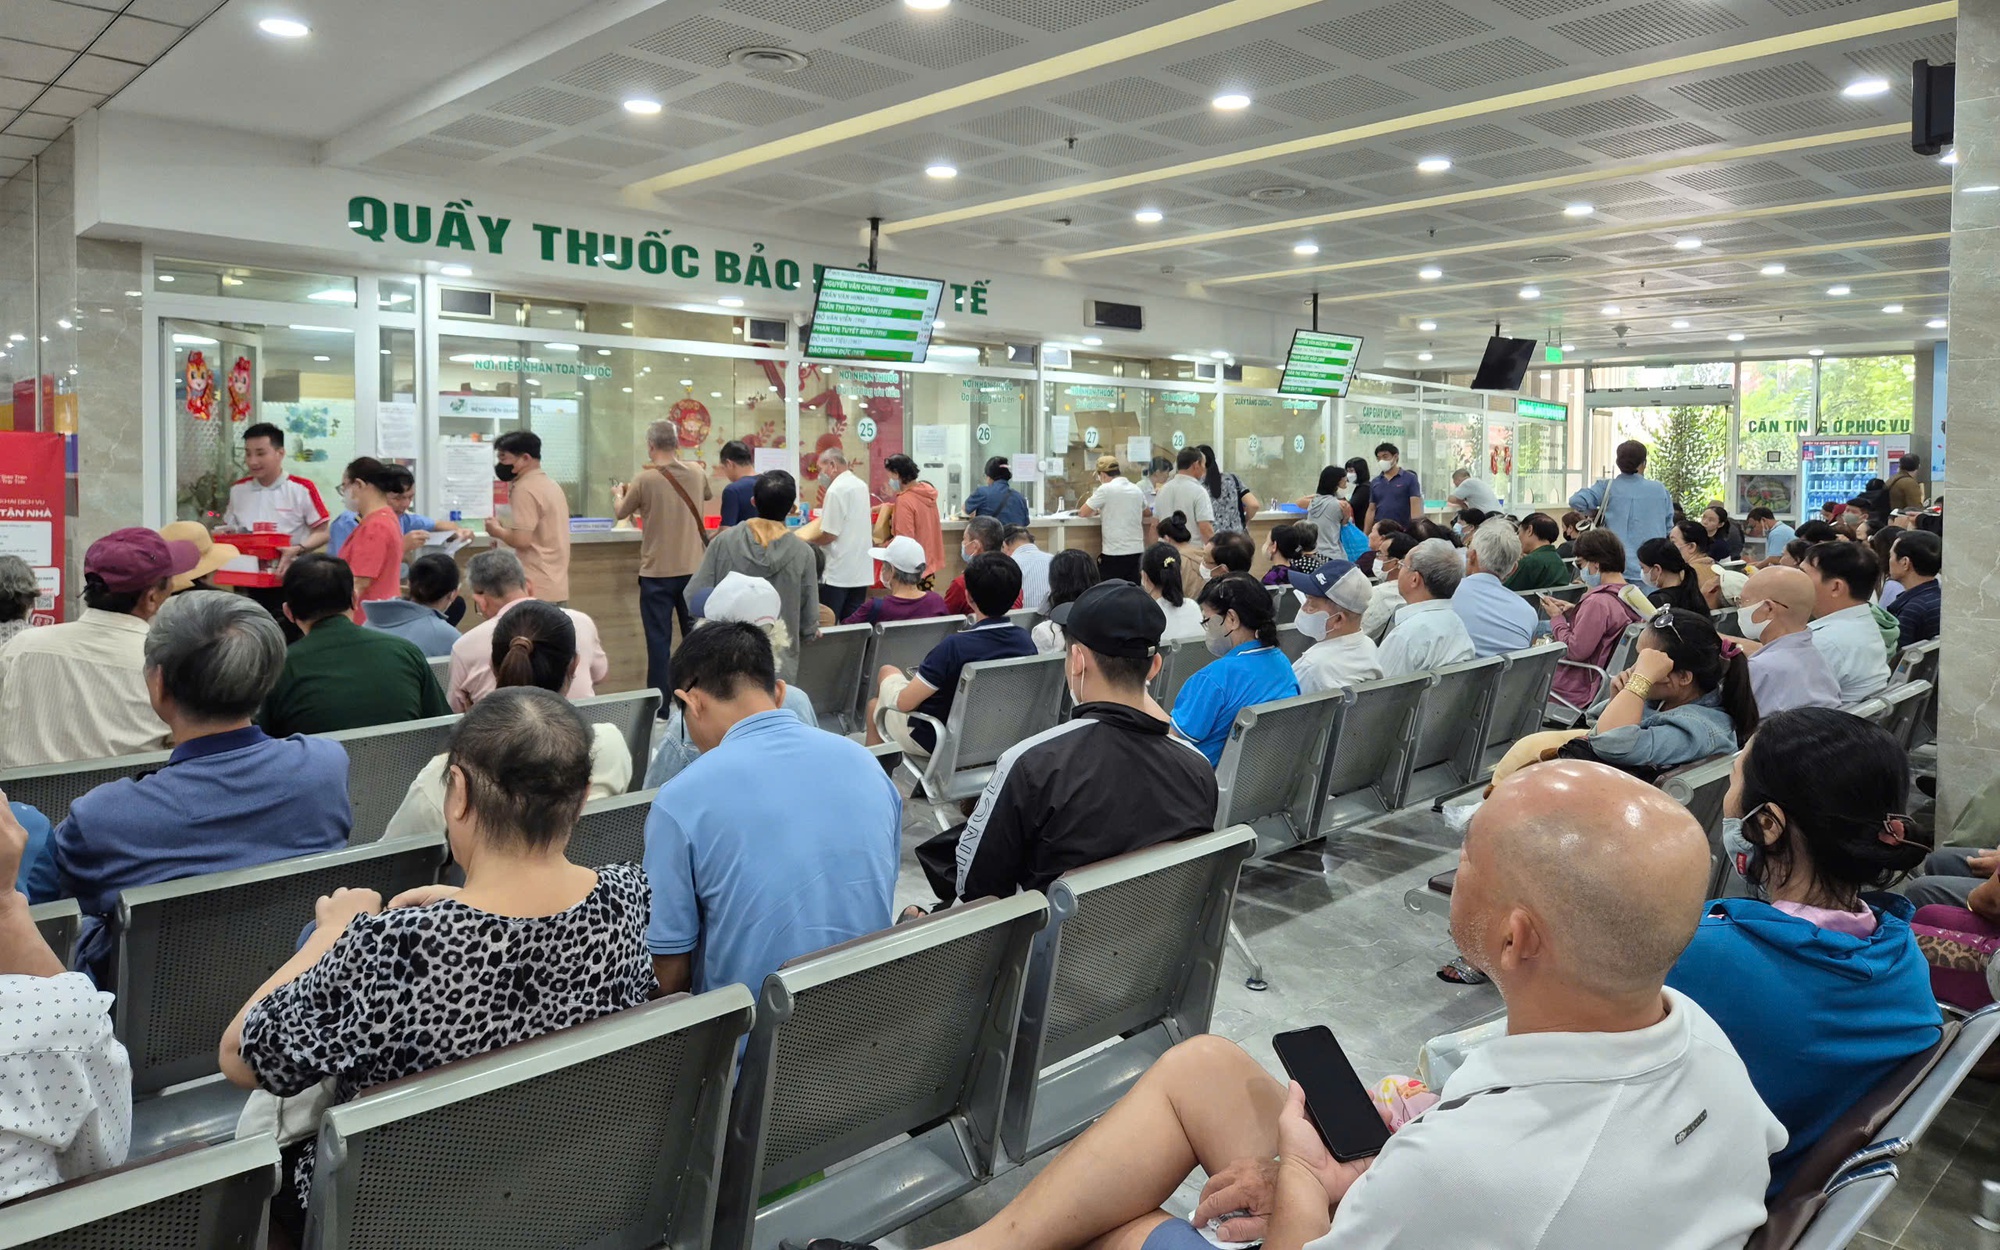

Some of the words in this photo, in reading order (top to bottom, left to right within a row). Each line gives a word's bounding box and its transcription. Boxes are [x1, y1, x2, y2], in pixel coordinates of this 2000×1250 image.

[347, 196, 512, 255] QUẦY
[532, 222, 700, 278] THUỐC
[715, 242, 801, 292] BẢO
[950, 279, 992, 316] TẾ
[555, 363, 576, 375] TOA
[860, 423, 874, 437] 25
[1749, 418, 1779, 433] CĂN
[1785, 420, 1808, 433] TIN
[978, 427, 990, 440] 26
[1087, 432, 1097, 444] 27
[1174, 435, 1183, 446] 28
[26, 506, 53, 518] NHÀ
